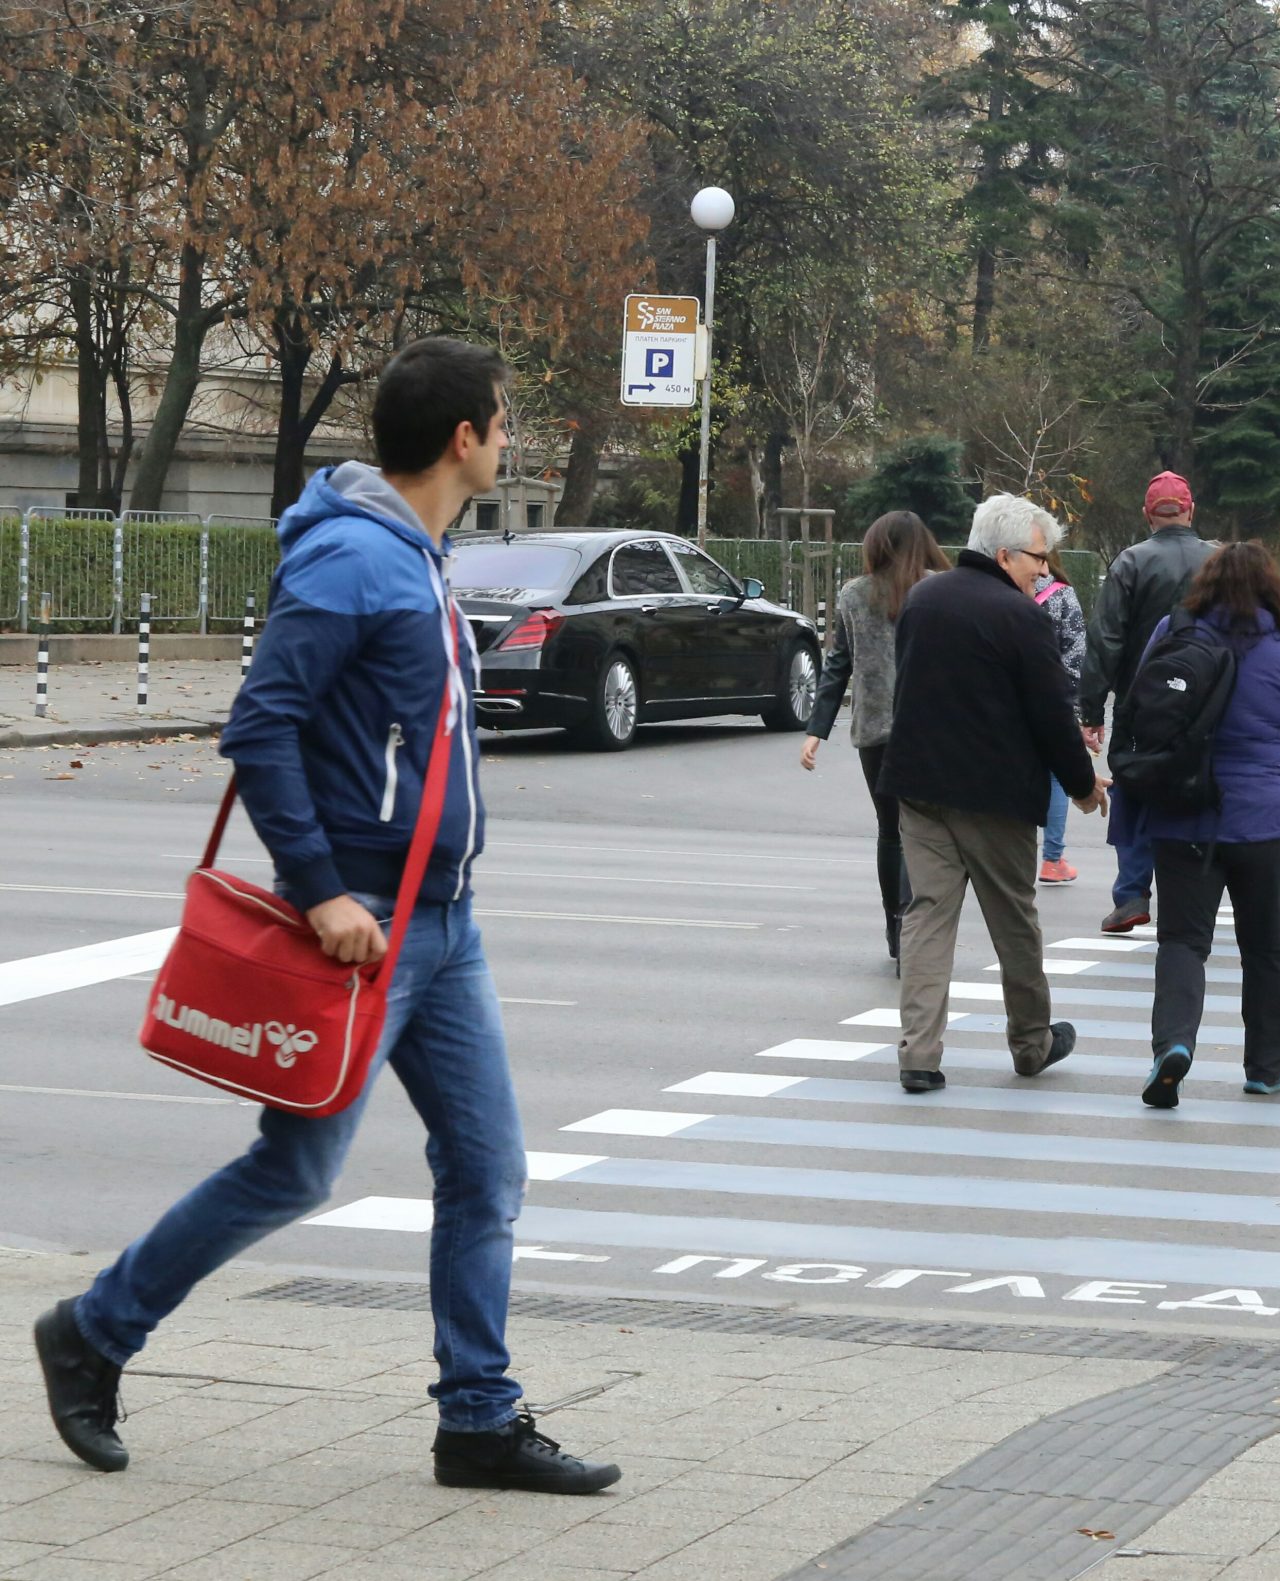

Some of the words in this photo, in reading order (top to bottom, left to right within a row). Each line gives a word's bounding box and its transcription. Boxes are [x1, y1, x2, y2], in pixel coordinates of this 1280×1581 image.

[656, 307, 672, 315] SAN
[654, 315, 687, 324] STEFANO
[652, 323, 674, 331] PLAZA
[635, 335, 659, 343] ПЛАТЕН
[660, 336, 687, 344] ПАРКИНГ
[652, 352, 669, 374] P
[665, 384, 681, 393] 450
